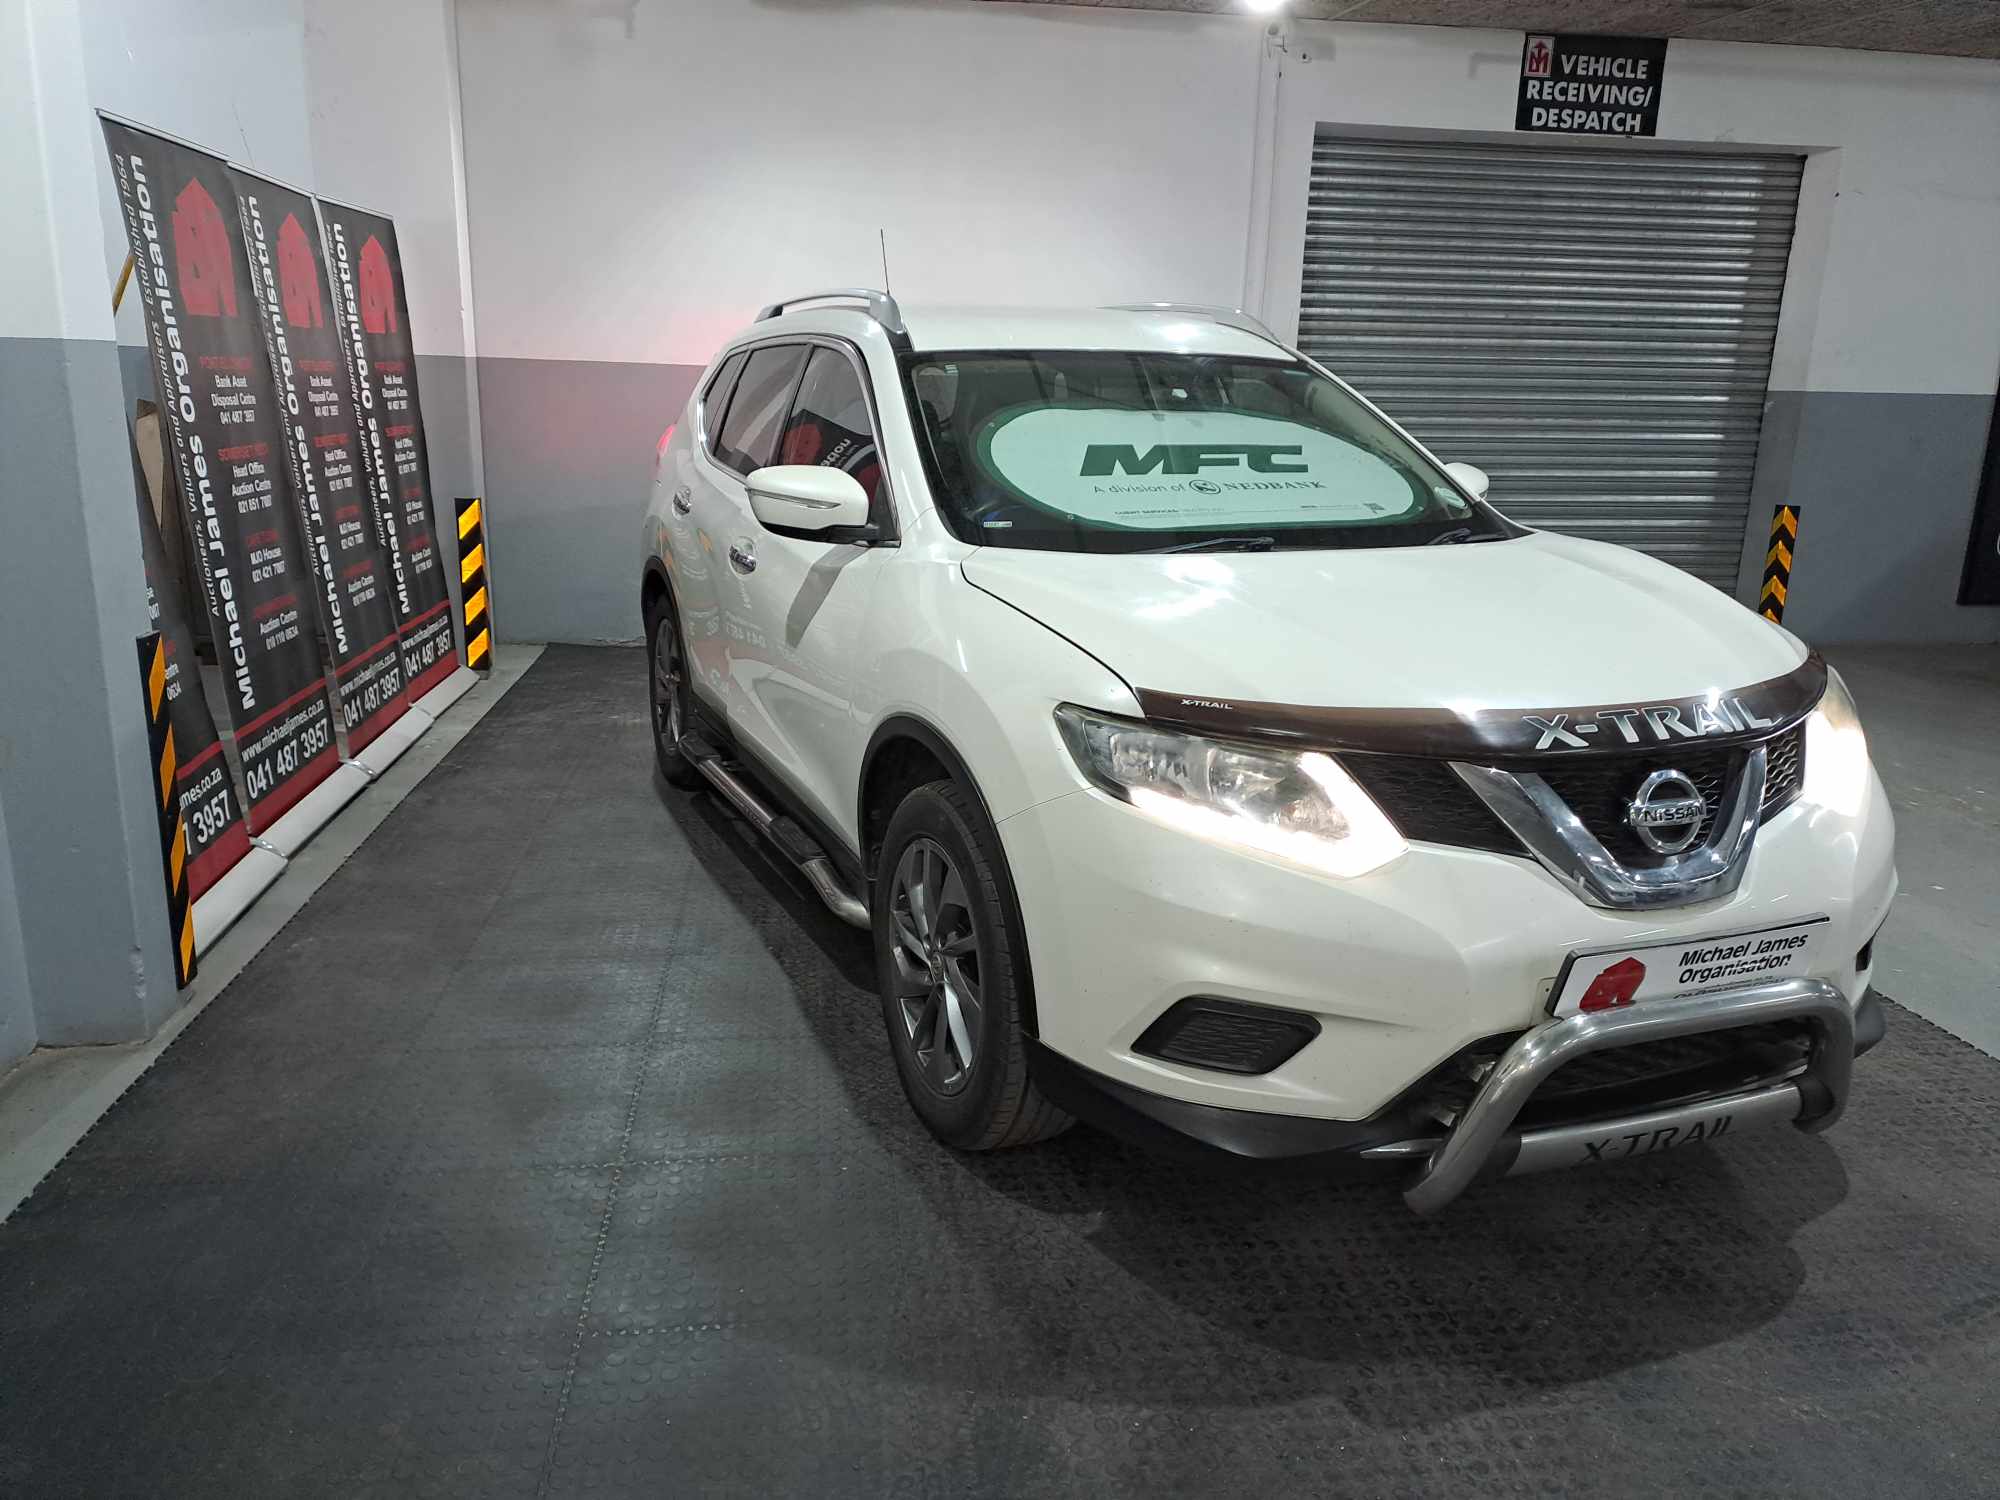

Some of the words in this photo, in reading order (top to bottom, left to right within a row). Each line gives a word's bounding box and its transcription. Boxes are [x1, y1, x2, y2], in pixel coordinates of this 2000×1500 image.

[1526, 79, 1653, 107] RECEIVING/
[1561, 54, 1648, 80] VEHICLE
[1531, 107, 1642, 133] DESPATCH
[114, 154, 130, 198] 1964
[130, 155, 196, 423] Organisation
[248, 195, 300, 416] Organisation
[333, 223, 373, 410] Organisation
[152, 320, 177, 412] Appraisers
[170, 415, 184, 448] and
[179, 452, 198, 512] Valuers
[294, 425, 323, 527] James
[367, 417, 391, 505] James
[1080, 444, 1309, 476] MFC
[1094, 485, 1105, 494] A
[1109, 483, 1169, 494] division
[1171, 483, 1186, 494] of
[1223, 480, 1328, 490] NEDBANK
[189, 435, 225, 557] James
[383, 512, 411, 614] Michael
[315, 535, 349, 654] Michael
[214, 568, 256, 710] Michael
[405, 653, 422, 677] 041
[422, 641, 434, 665] 487
[435, 629, 451, 656] 3957
[343, 696, 363, 727] 041
[364, 683, 380, 712] 487
[380, 667, 401, 700] 3957
[1181, 698, 1233, 710] X-TRAIL
[1521, 697, 1784, 750] X-TRAIL
[241, 699, 325, 762] www.michaeljames.co.za
[246, 758, 274, 799] 041
[277, 739, 299, 776] 487
[300, 718, 328, 758] 3957
[193, 789, 231, 843] 3957
[1643, 805, 1706, 822] NISSAN
[1678, 941, 1751, 967] Michael
[1752, 934, 1808, 956] James
[1678, 953, 1792, 984] Organisation
[1573, 1115, 1736, 1165] X-TRAIL
